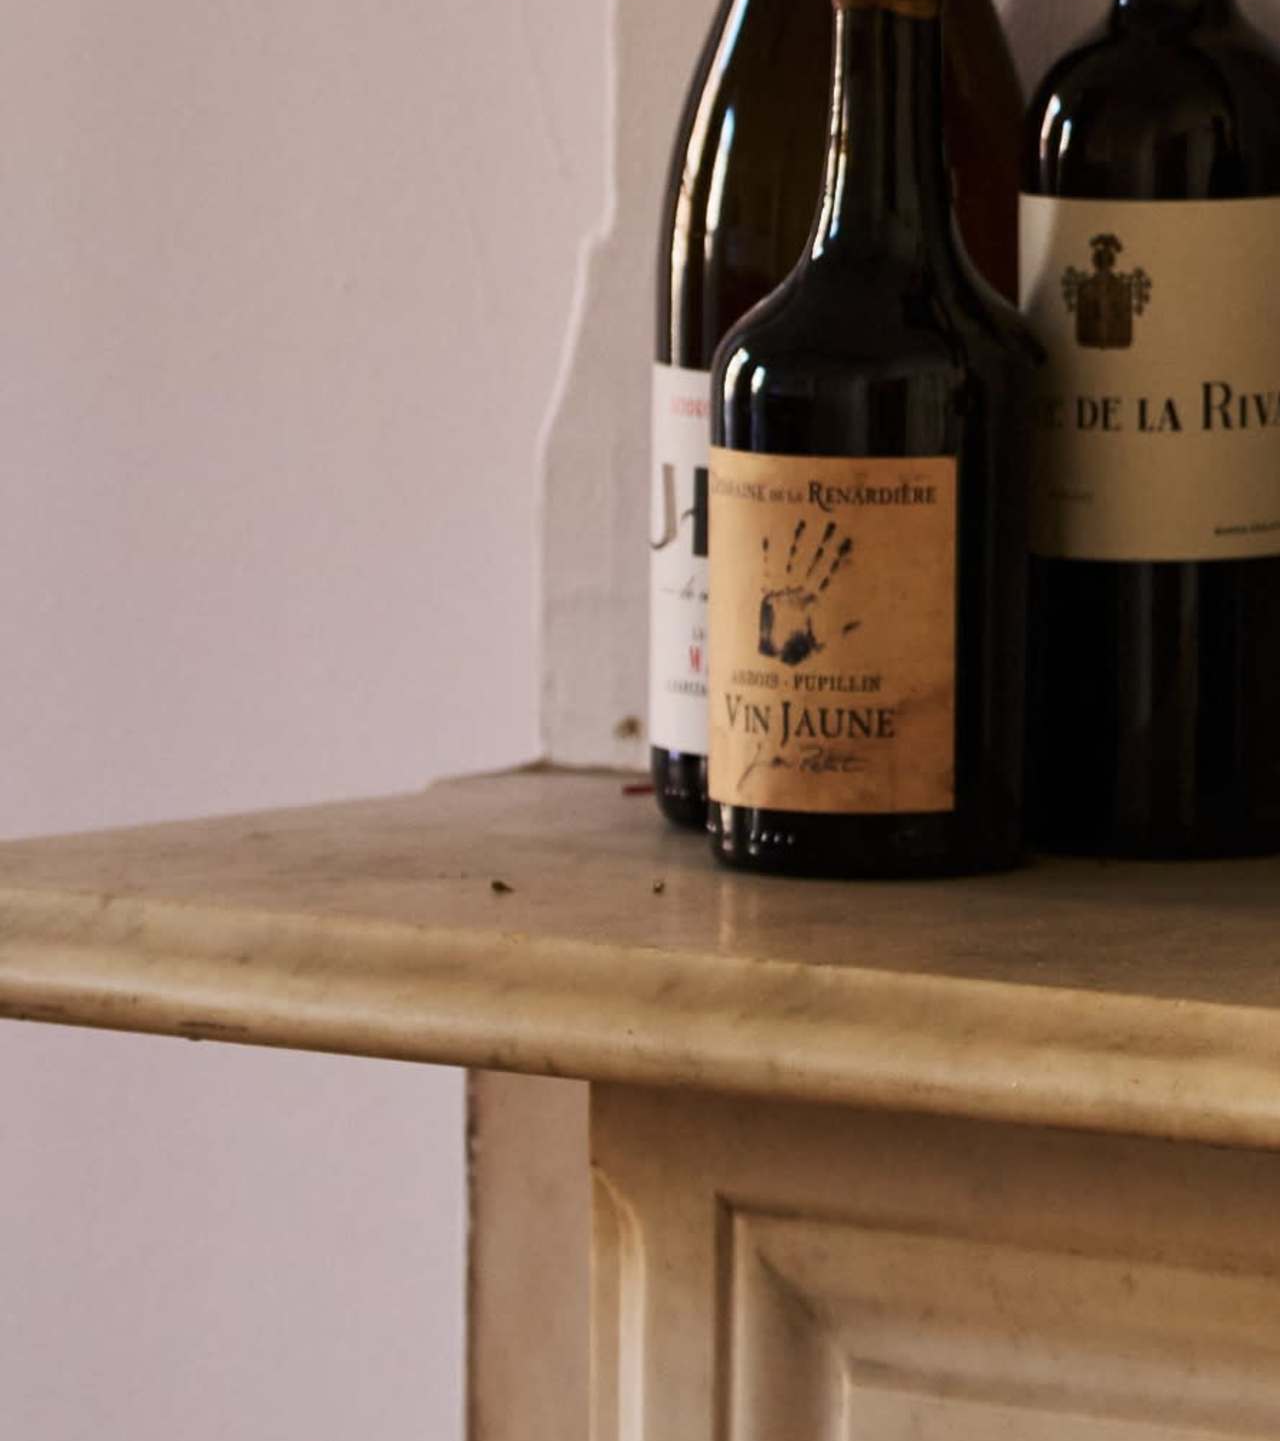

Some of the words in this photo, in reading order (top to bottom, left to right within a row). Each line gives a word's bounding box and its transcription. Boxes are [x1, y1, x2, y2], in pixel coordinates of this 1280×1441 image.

[1076, 396, 1122, 431] DE
[1138, 397, 1182, 432] LA
[792, 673, 882, 693] PUPILLIN
[724, 693, 771, 734] VIN
[780, 700, 897, 748] JAUNE
